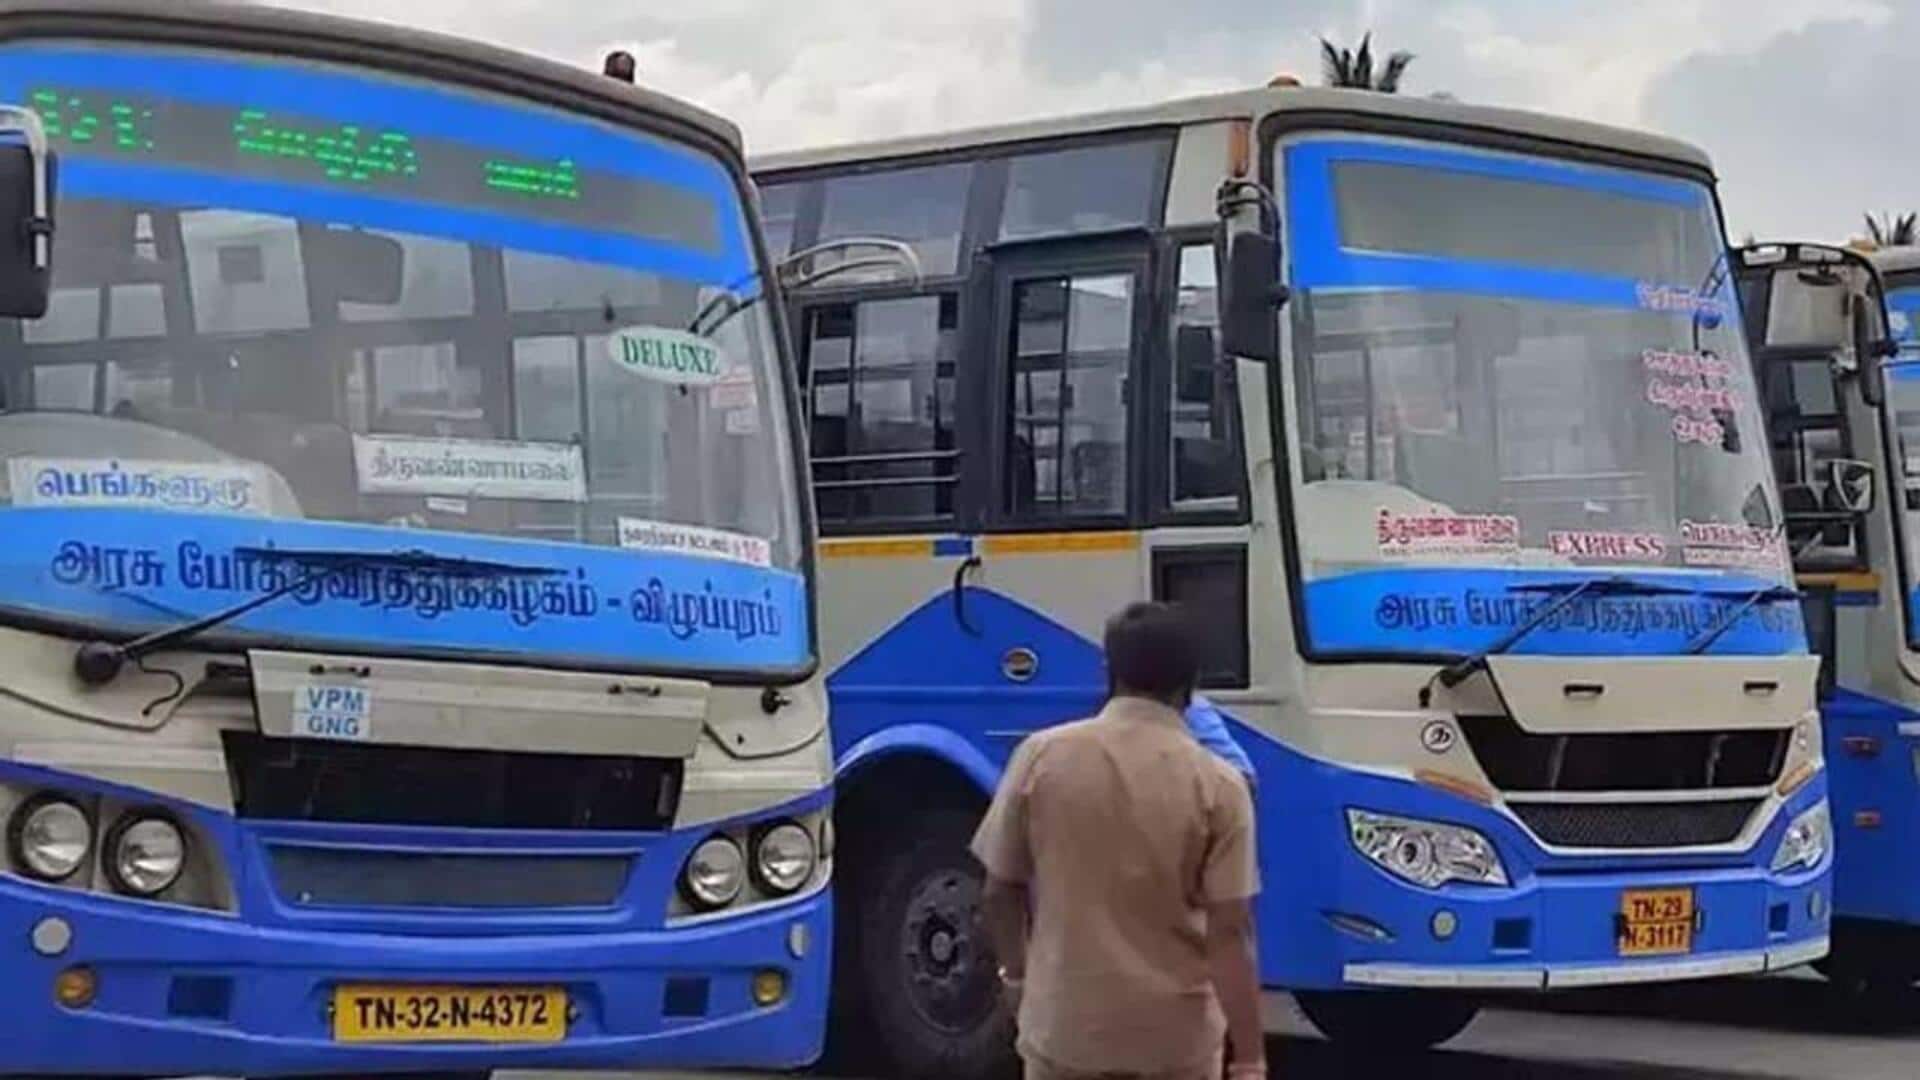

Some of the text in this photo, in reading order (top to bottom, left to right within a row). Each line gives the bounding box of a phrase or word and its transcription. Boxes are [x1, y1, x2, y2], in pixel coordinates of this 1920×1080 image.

[621, 335, 720, 375] DELUXE
[1550, 532, 1665, 557] EXPRESS
[50, 540, 166, 590] அரசு
[630, 577, 783, 641] விழுப்புரம்
[1374, 593, 1456, 630] அரசு
[307, 687, 364, 713] VPM
[307, 714, 360, 736] GNG
[1632, 896, 1683, 920] TN-29
[1623, 923, 1686, 948] N-3117
[354, 994, 548, 1030] TN-32-N-4372
